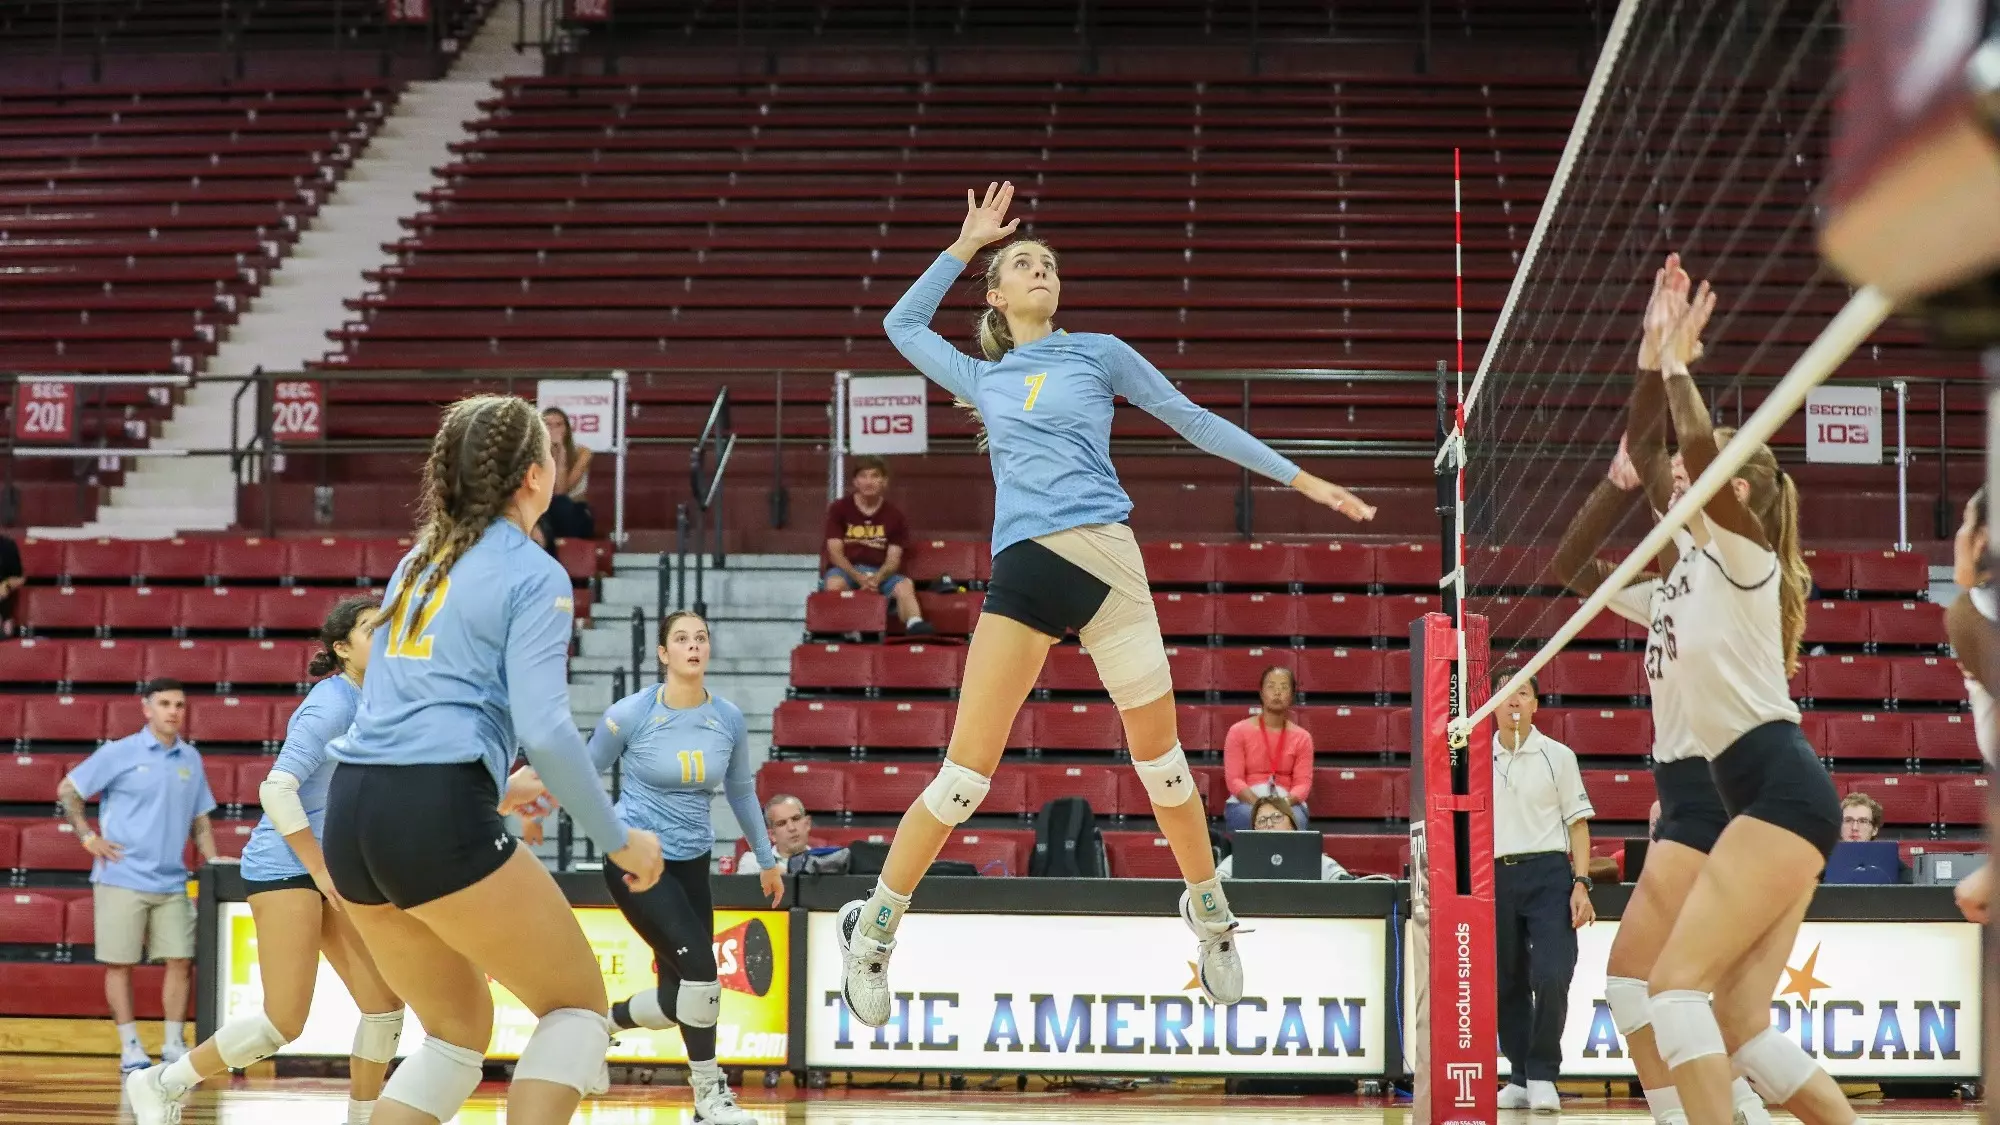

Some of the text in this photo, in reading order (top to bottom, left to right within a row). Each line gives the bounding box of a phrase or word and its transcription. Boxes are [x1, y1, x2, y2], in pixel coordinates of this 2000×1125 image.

[852, 395, 922, 407] SECTION
[1023, 372, 1047, 411] 7
[24, 402, 66, 432] 201
[271, 402, 320, 432] 202
[862, 413, 913, 435] 103
[1809, 403, 1878, 416] SECTION
[1817, 423, 1869, 444] 103
[384, 573, 452, 660] 12
[676, 750, 706, 784] 11
[1455, 922, 1473, 1049] sports imports
[825, 991, 1367, 1057] THE AMERICAN
